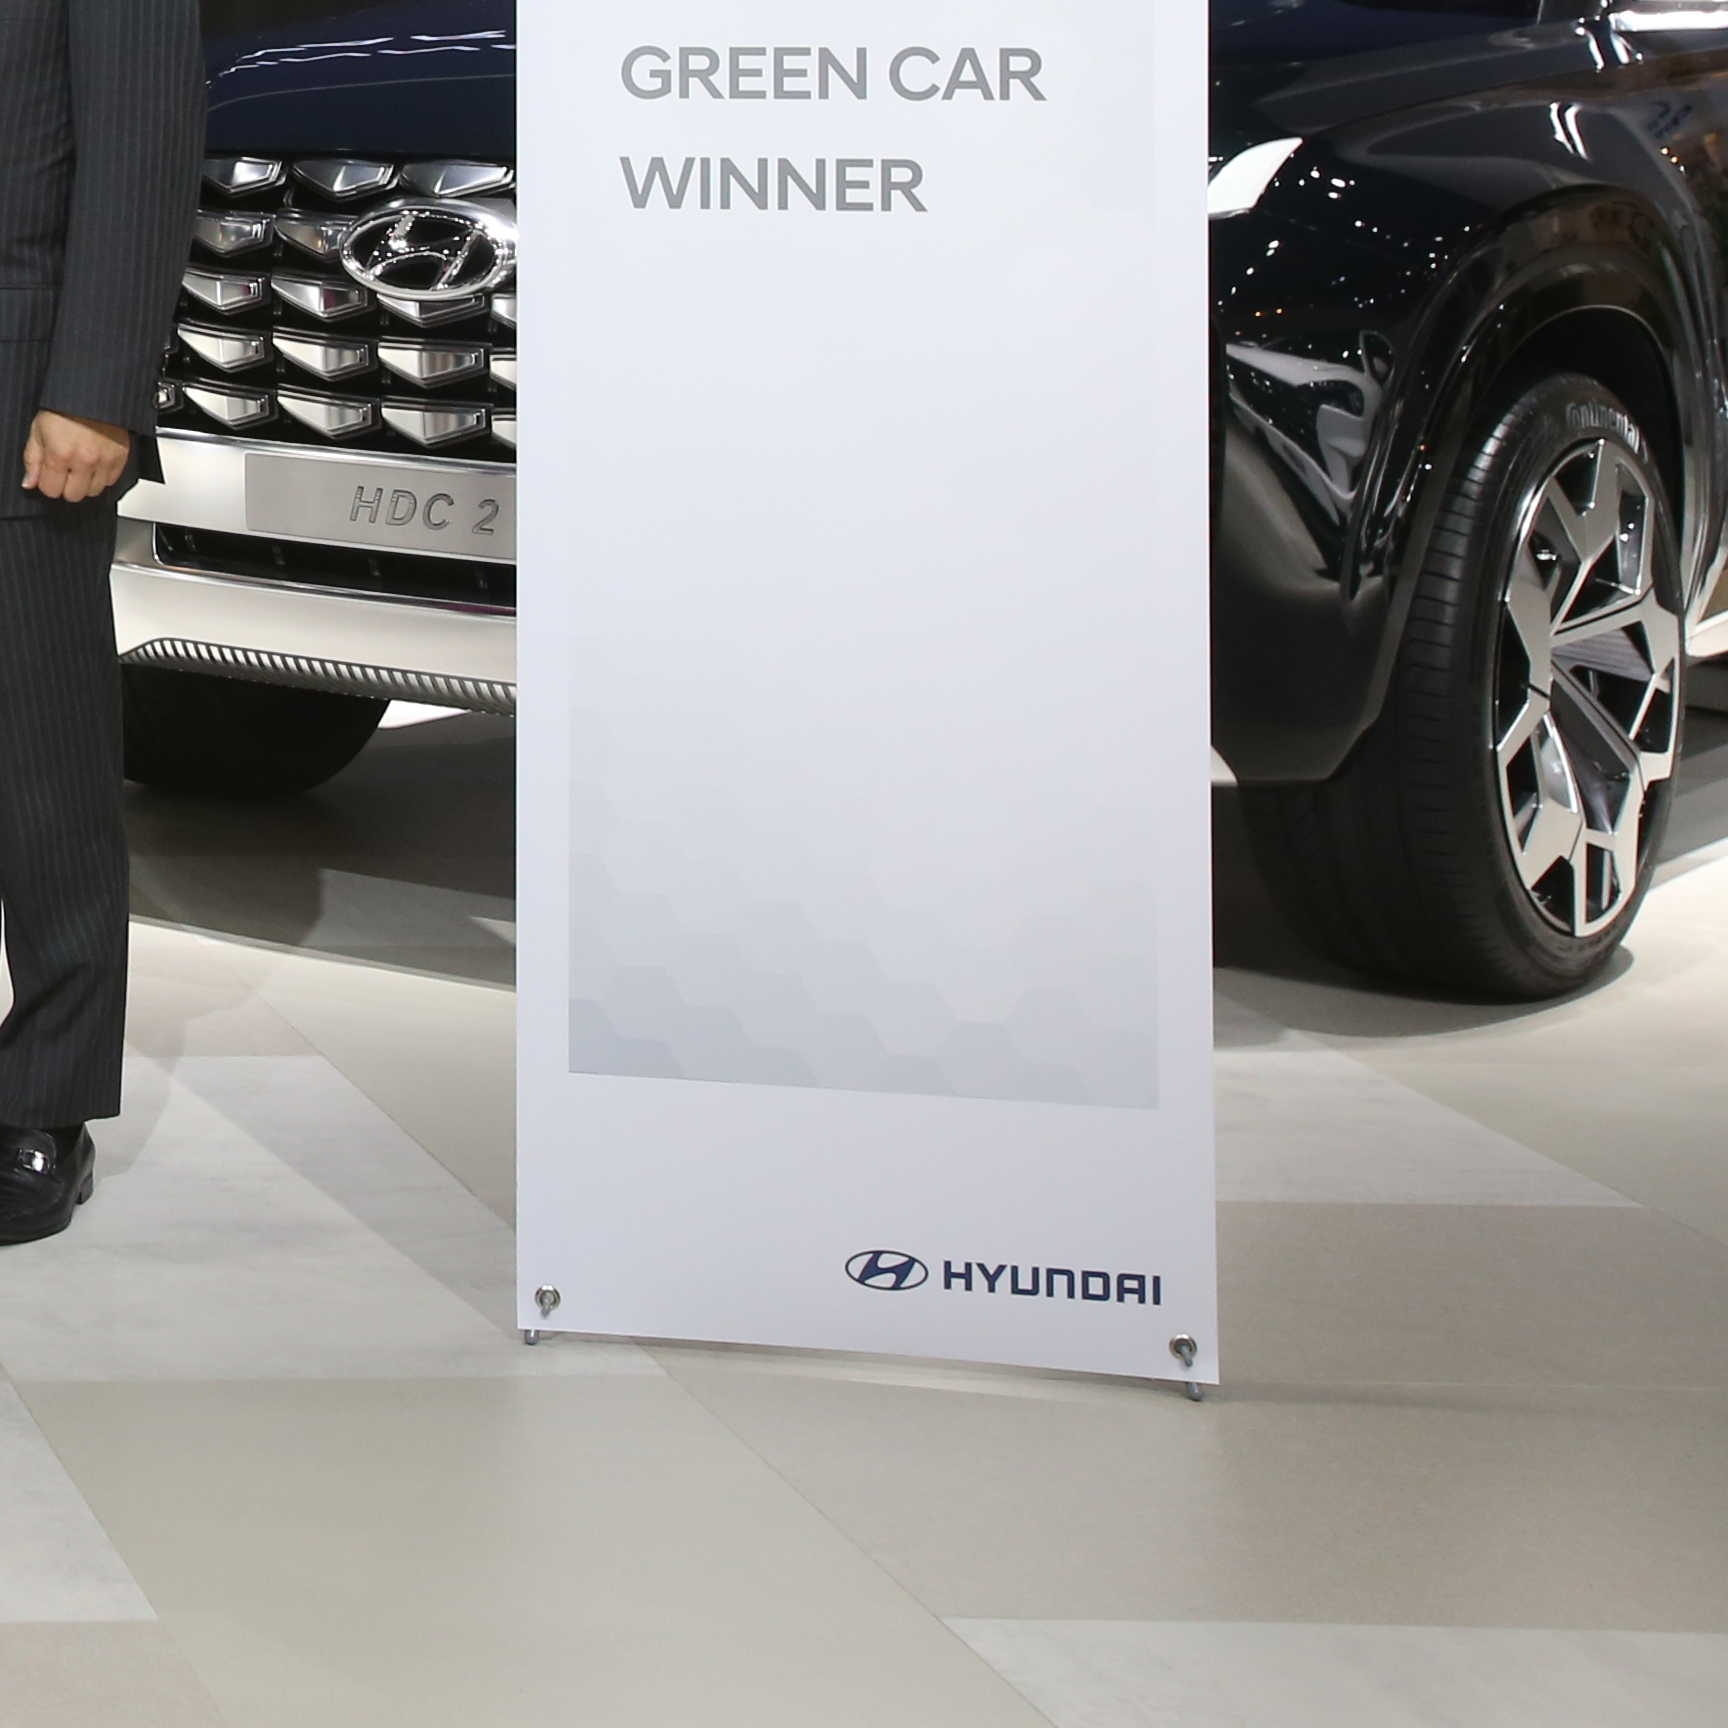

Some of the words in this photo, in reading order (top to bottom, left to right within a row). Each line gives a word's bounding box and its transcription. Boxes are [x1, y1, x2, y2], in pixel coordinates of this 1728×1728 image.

[621, 45, 867, 101] GREEN
[889, 45, 1047, 102] CAR
[619, 156, 928, 212] WINNER
[349, 485, 455, 531] HDC
[471, 498, 500, 536] 2
[943, 1260, 1162, 1306] HYUNDAI
